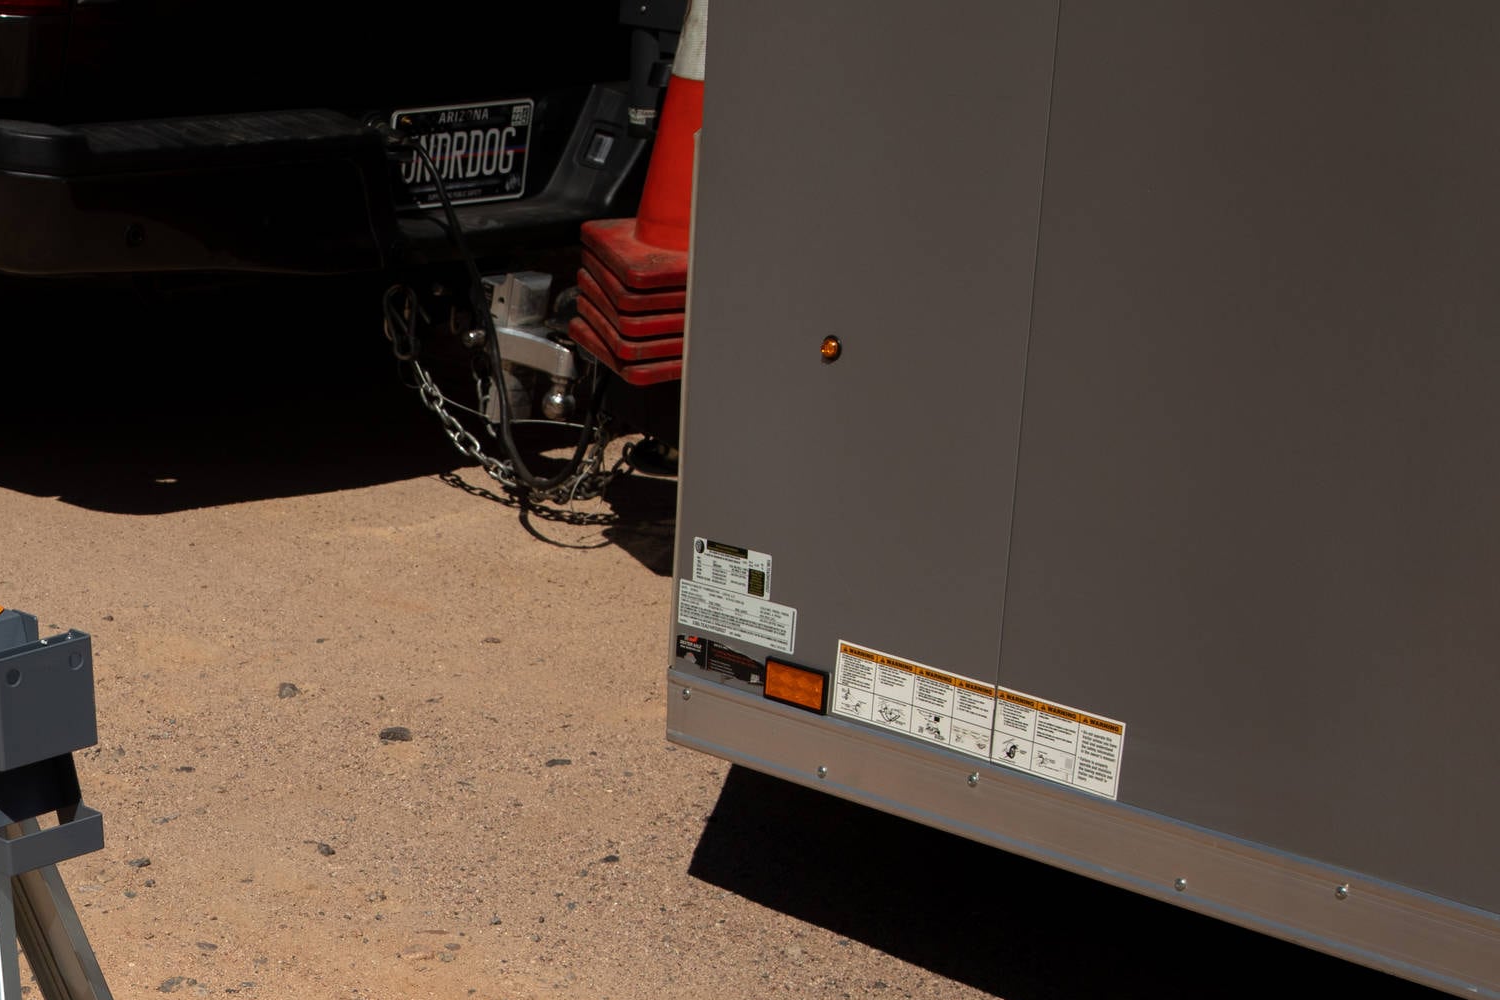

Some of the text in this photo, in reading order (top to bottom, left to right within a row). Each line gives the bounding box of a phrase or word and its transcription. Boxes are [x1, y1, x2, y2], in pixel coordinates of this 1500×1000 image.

[438, 108, 489, 124] ARIZONA
[849, 648, 874, 661] WARNING
[886, 658, 913, 672] WARNING
[925, 669, 952, 684] WARNING
[965, 681, 993, 696] WARNING
[1006, 693, 1035, 708] WARNING
[1047, 705, 1077, 720] WARNING
[1090, 718, 1119, 732] WARNING
